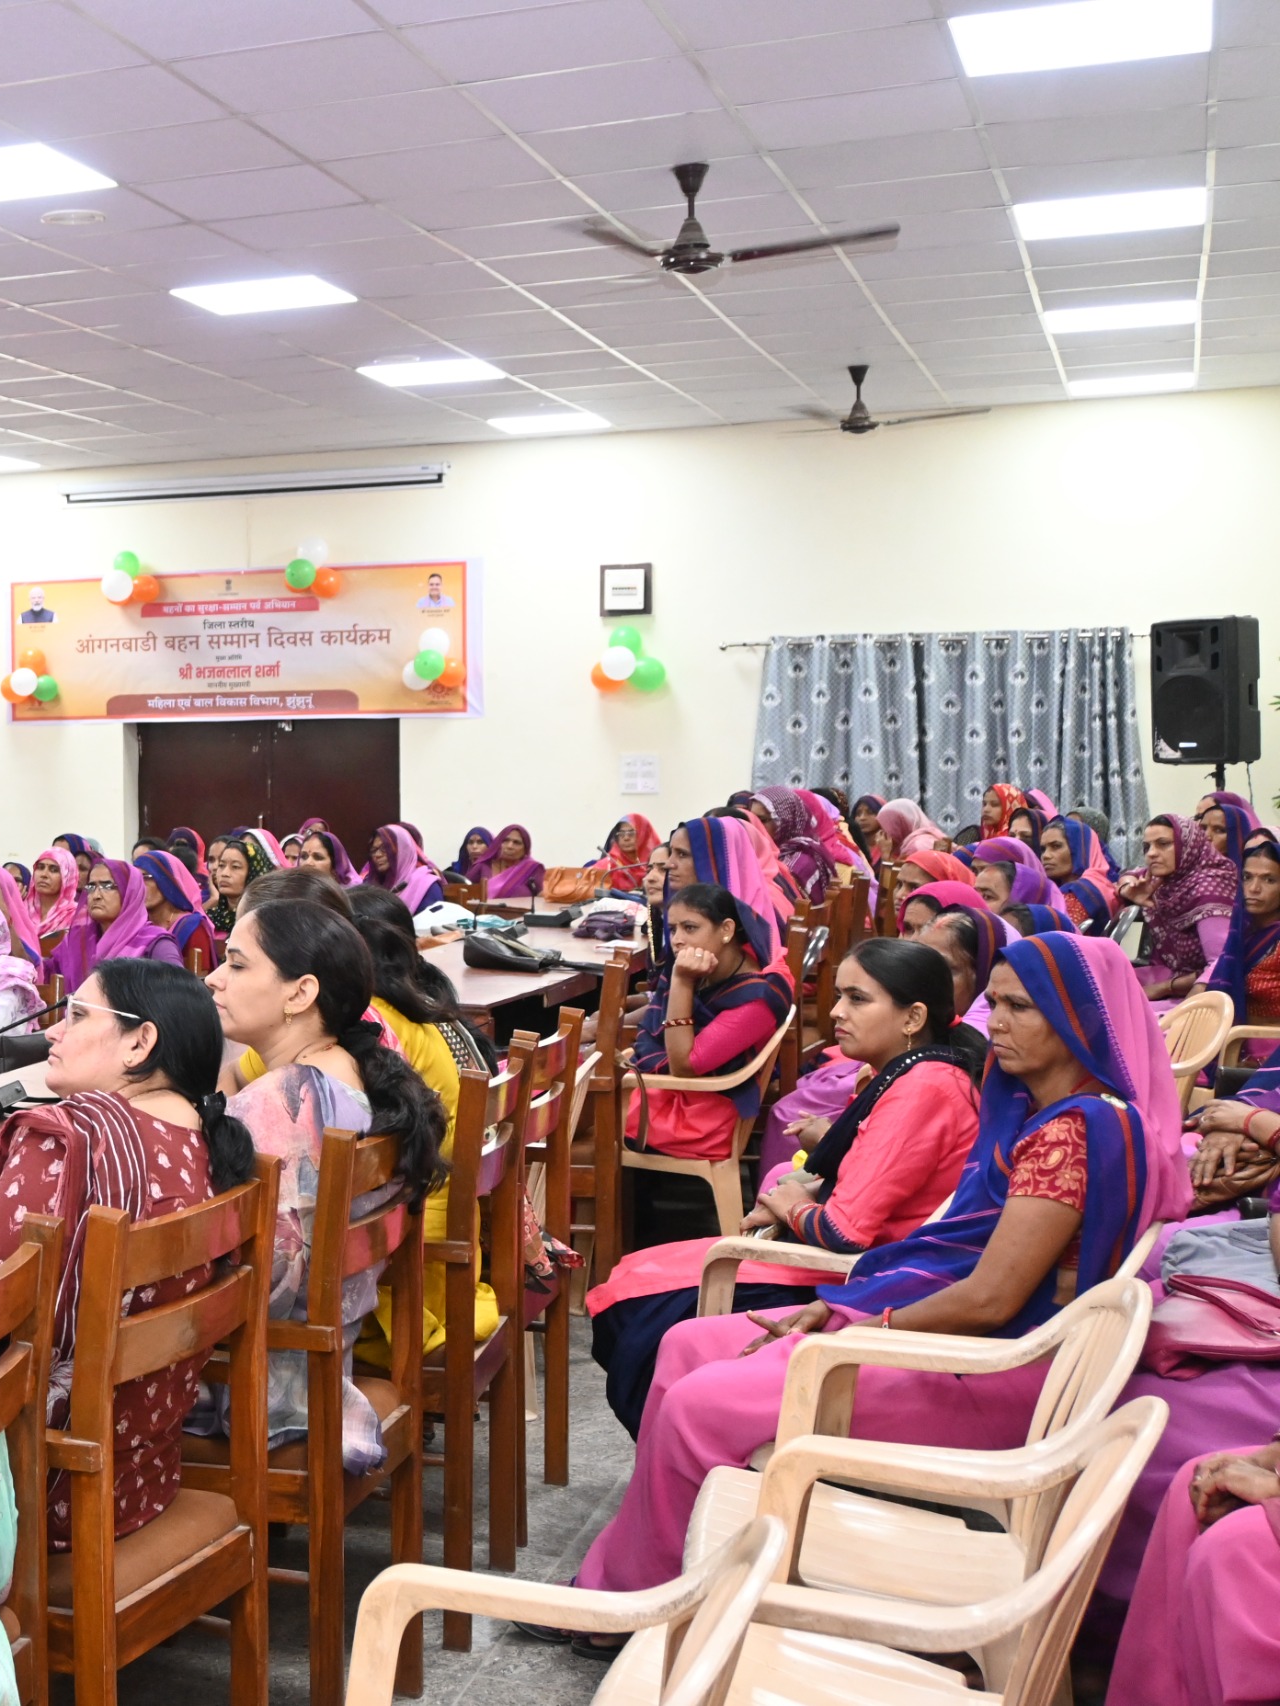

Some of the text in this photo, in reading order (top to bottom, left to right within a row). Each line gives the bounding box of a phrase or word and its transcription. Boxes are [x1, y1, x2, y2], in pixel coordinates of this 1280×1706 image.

[203, 617, 255, 630] जिला स्तरीय
[163, 634, 201, 653] बहन
[206, 632, 261, 651] सम्मान
[267, 625, 314, 649] दिवस
[320, 623, 392, 647] कार्यक्रम
[178, 660, 281, 680] श्री भजनलाल शर्मा
[147, 696, 176, 709] महिला
[177, 695, 192, 710] एवं
[193, 697, 214, 708] बाल
[215, 695, 247, 708] विकास
[249, 694, 284, 708] विभाग,
